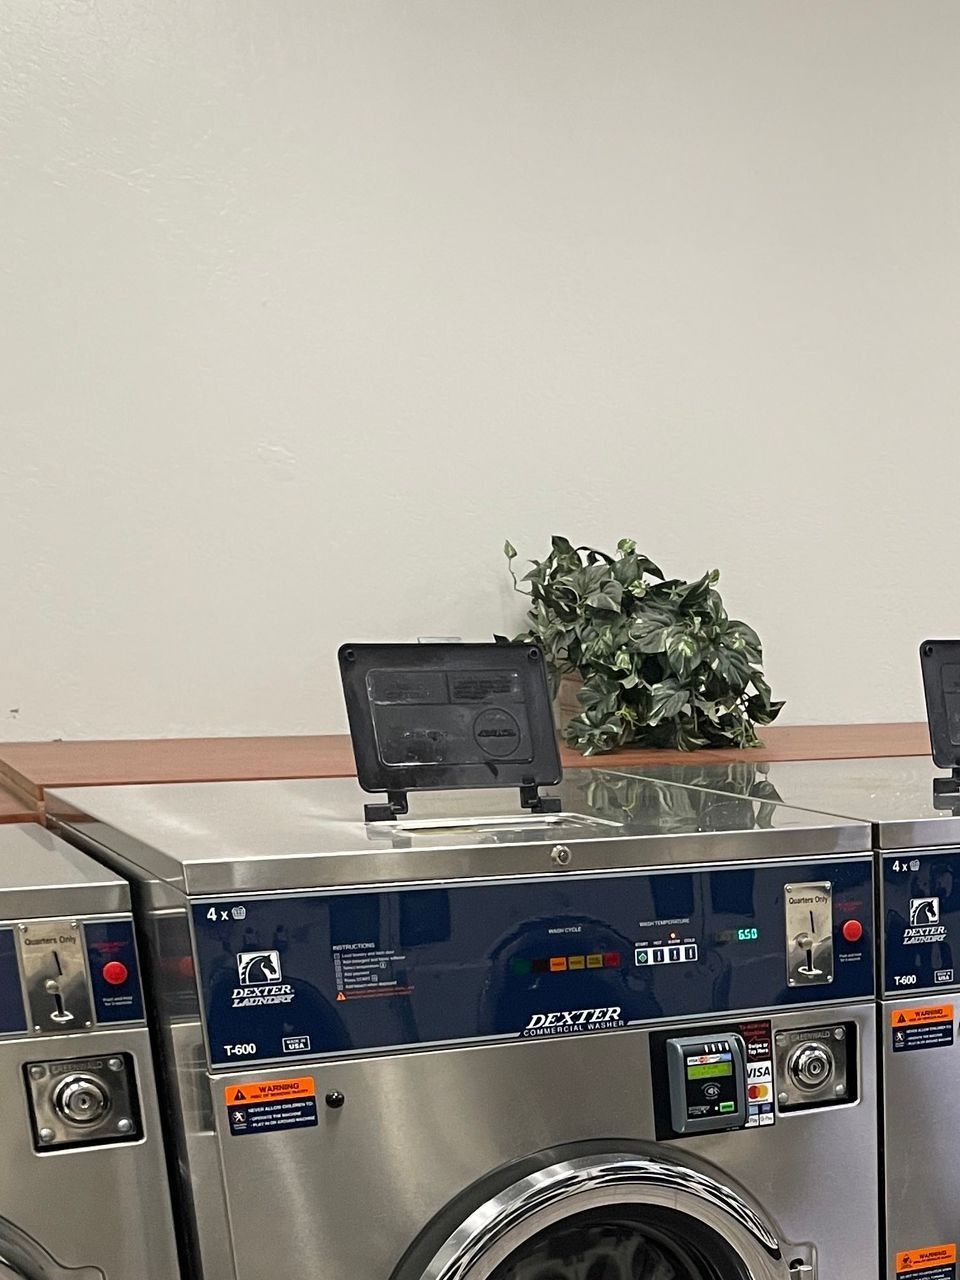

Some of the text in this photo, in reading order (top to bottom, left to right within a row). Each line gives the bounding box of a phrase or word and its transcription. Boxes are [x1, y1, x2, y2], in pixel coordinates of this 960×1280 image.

[892, 860, 908, 873] 4 x
[815, 896, 828, 904] Only
[207, 907, 229, 921] 4 x
[903, 926, 945, 938] DEXTER
[59, 936, 76, 944] Only
[332, 942, 375, 951] INSTRUCTIONS
[894, 974, 917, 986] T-600
[232, 985, 292, 998] DEXTER
[232, 994, 295, 1007] LAUNDRY
[525, 1006, 621, 1029] DEXTER
[523, 1021, 624, 1037] COMMERCIAL WASHER
[224, 1043, 256, 1056] T-600
[747, 1067, 770, 1078] VISA
[258, 1083, 300, 1093] WARNING
